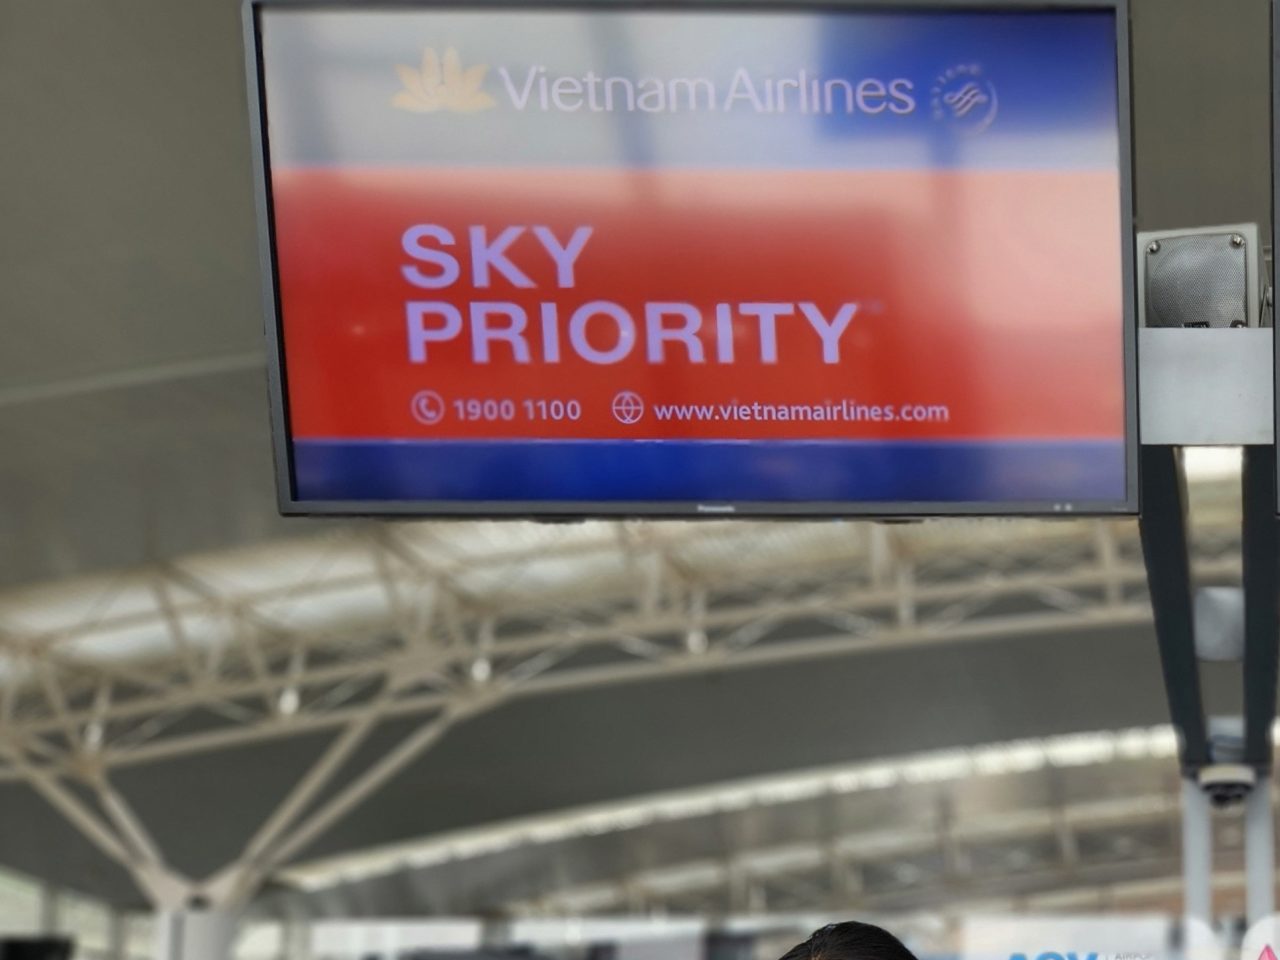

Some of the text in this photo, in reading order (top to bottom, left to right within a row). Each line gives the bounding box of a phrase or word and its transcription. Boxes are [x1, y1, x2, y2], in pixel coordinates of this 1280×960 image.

[500, 65, 717, 113] Vietnam
[723, 64, 917, 113] Airlines
[401, 224, 594, 289] SKY
[406, 300, 858, 364] PRIORITY
[453, 400, 582, 421] 1900 1100
[653, 398, 950, 422] www.vietnamairlines.com
